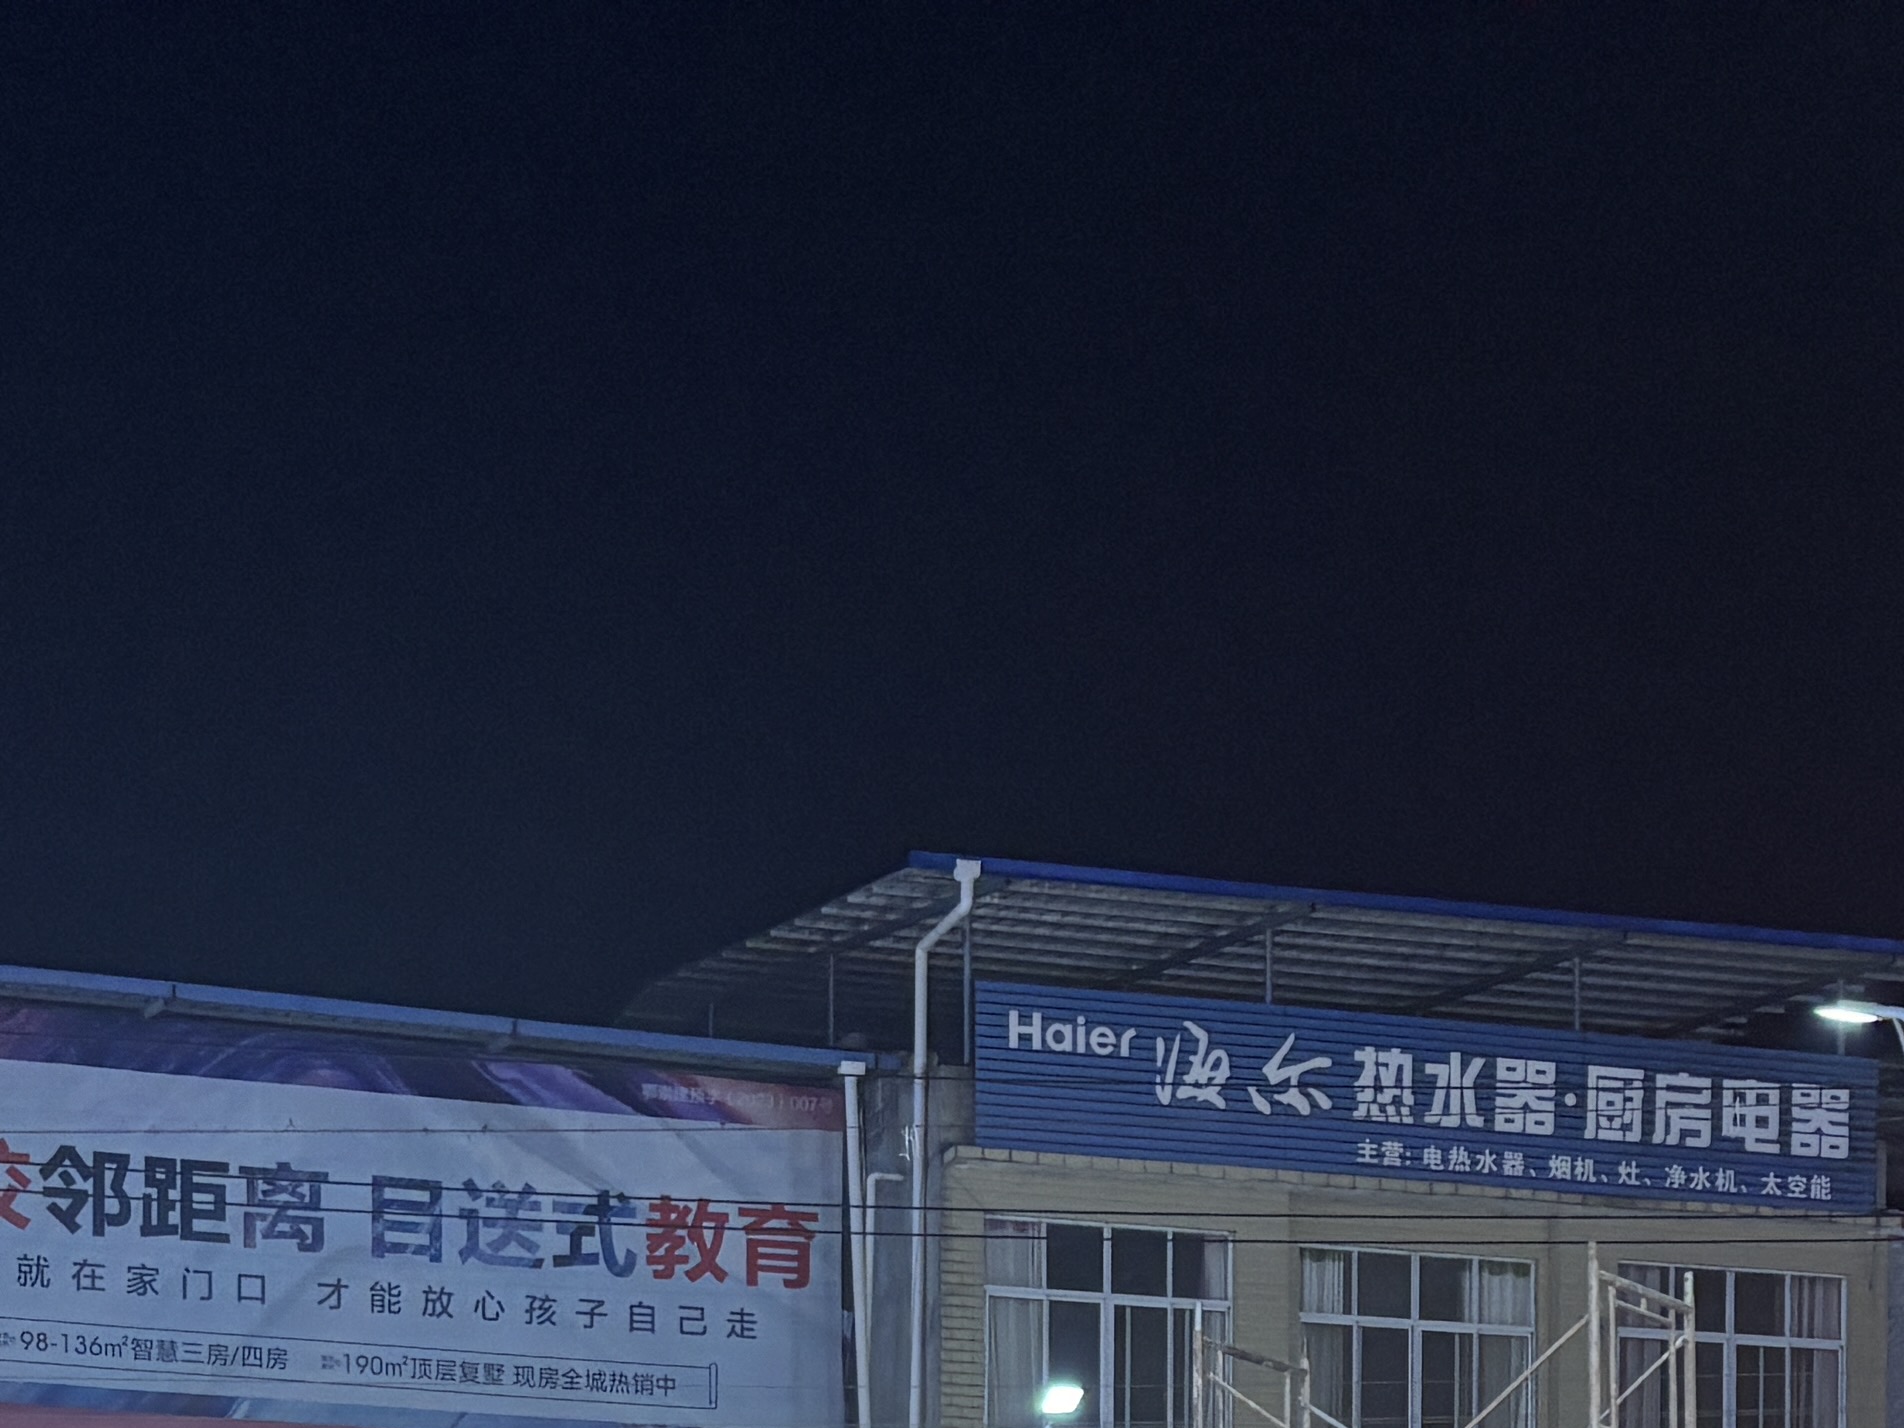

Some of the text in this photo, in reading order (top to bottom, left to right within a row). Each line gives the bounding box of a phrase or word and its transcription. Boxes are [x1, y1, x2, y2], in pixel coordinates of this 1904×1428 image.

[1007, 1008, 1138, 1060] Haier
[1154, 1019, 1334, 1117] 海尔
[370, 1174, 820, 1290] 目送式教育
[316, 1277, 759, 1341] 才能放心孩子自己走
